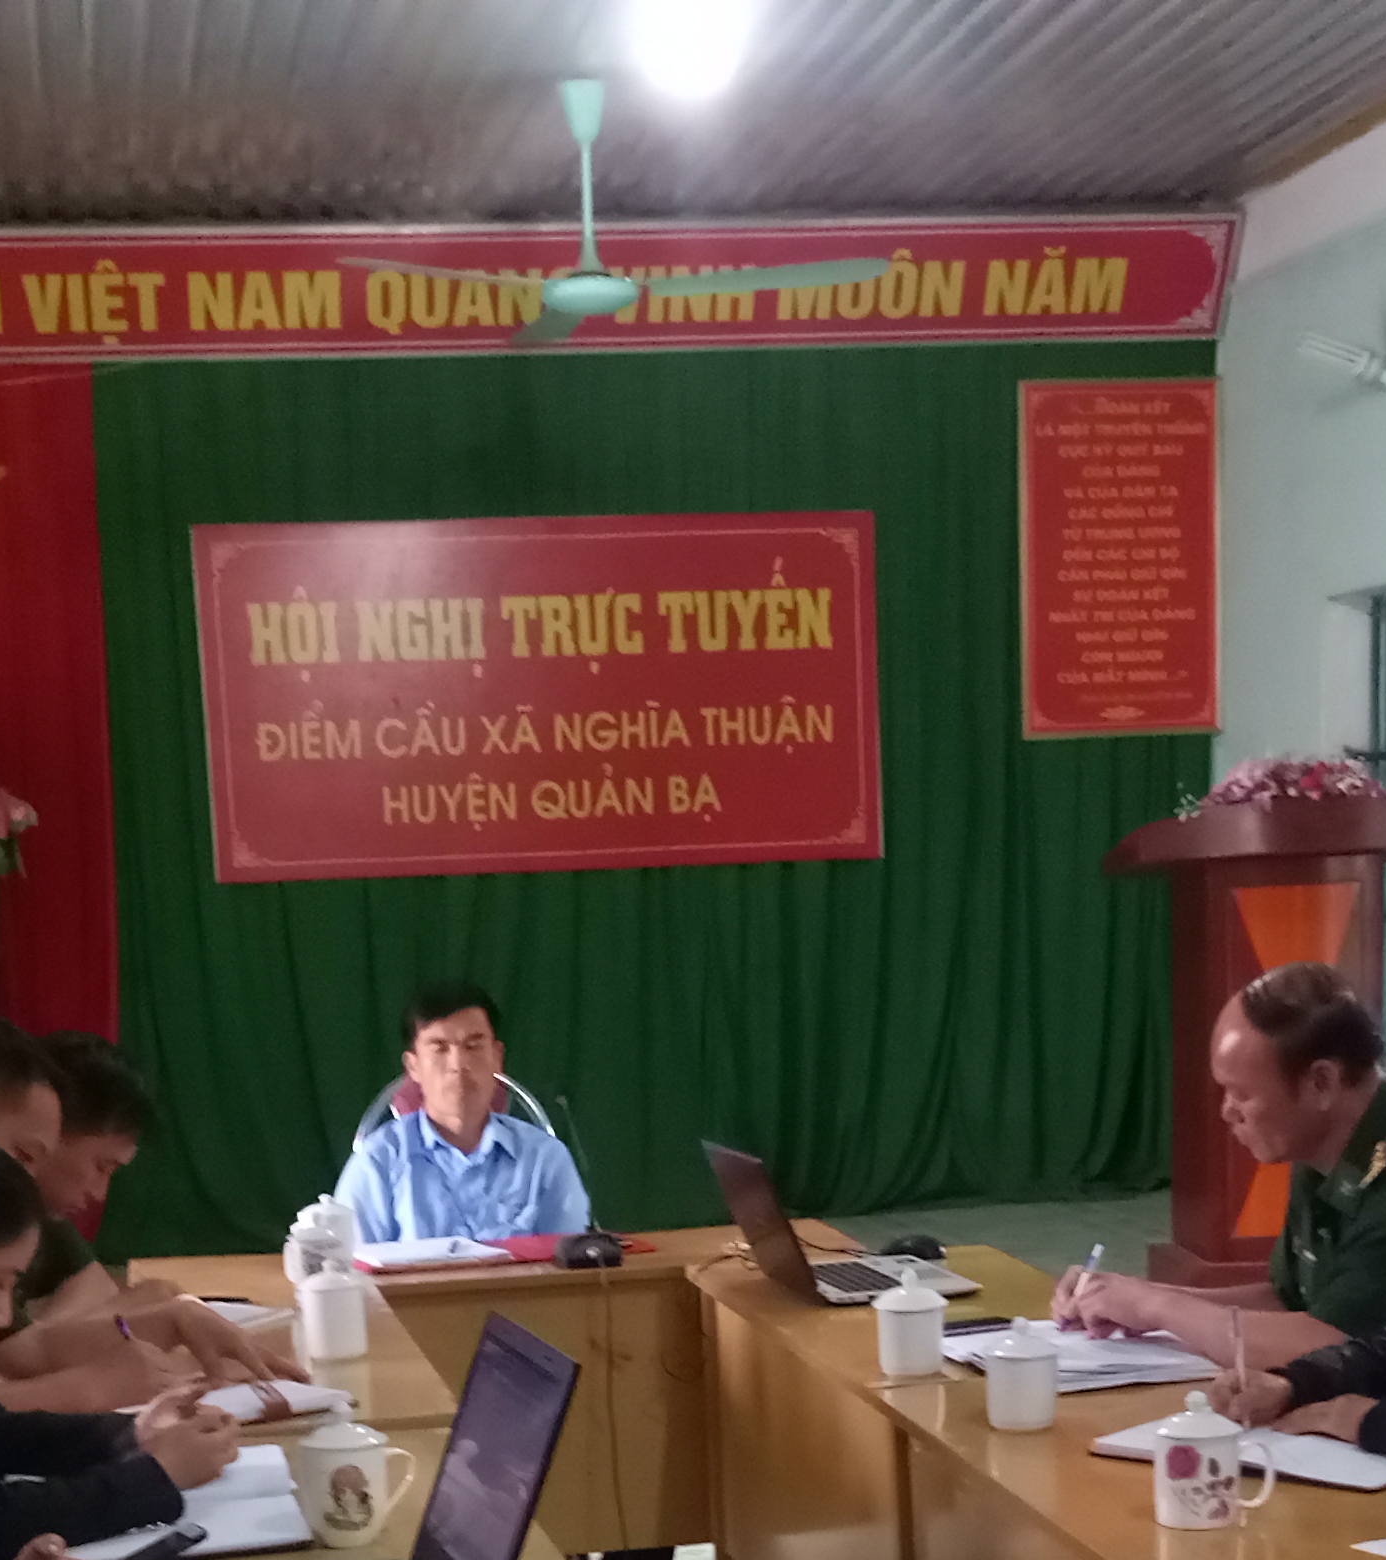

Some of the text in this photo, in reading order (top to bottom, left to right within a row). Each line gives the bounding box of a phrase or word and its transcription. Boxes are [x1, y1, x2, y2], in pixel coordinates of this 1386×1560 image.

[21, 260, 165, 347] VIỆT
[186, 267, 341, 333] NAM
[366, 265, 580, 335] QUAN
[983, 246, 1128, 316] NĂM
[247, 555, 833, 682] HỘI NGHỊ TRỰC TUYẾN
[255, 695, 833, 761] ĐIỂM CẦU XÃ NGHĨA THUẬN
[382, 762, 722, 832] HUYỆN QUẢN BẠ
